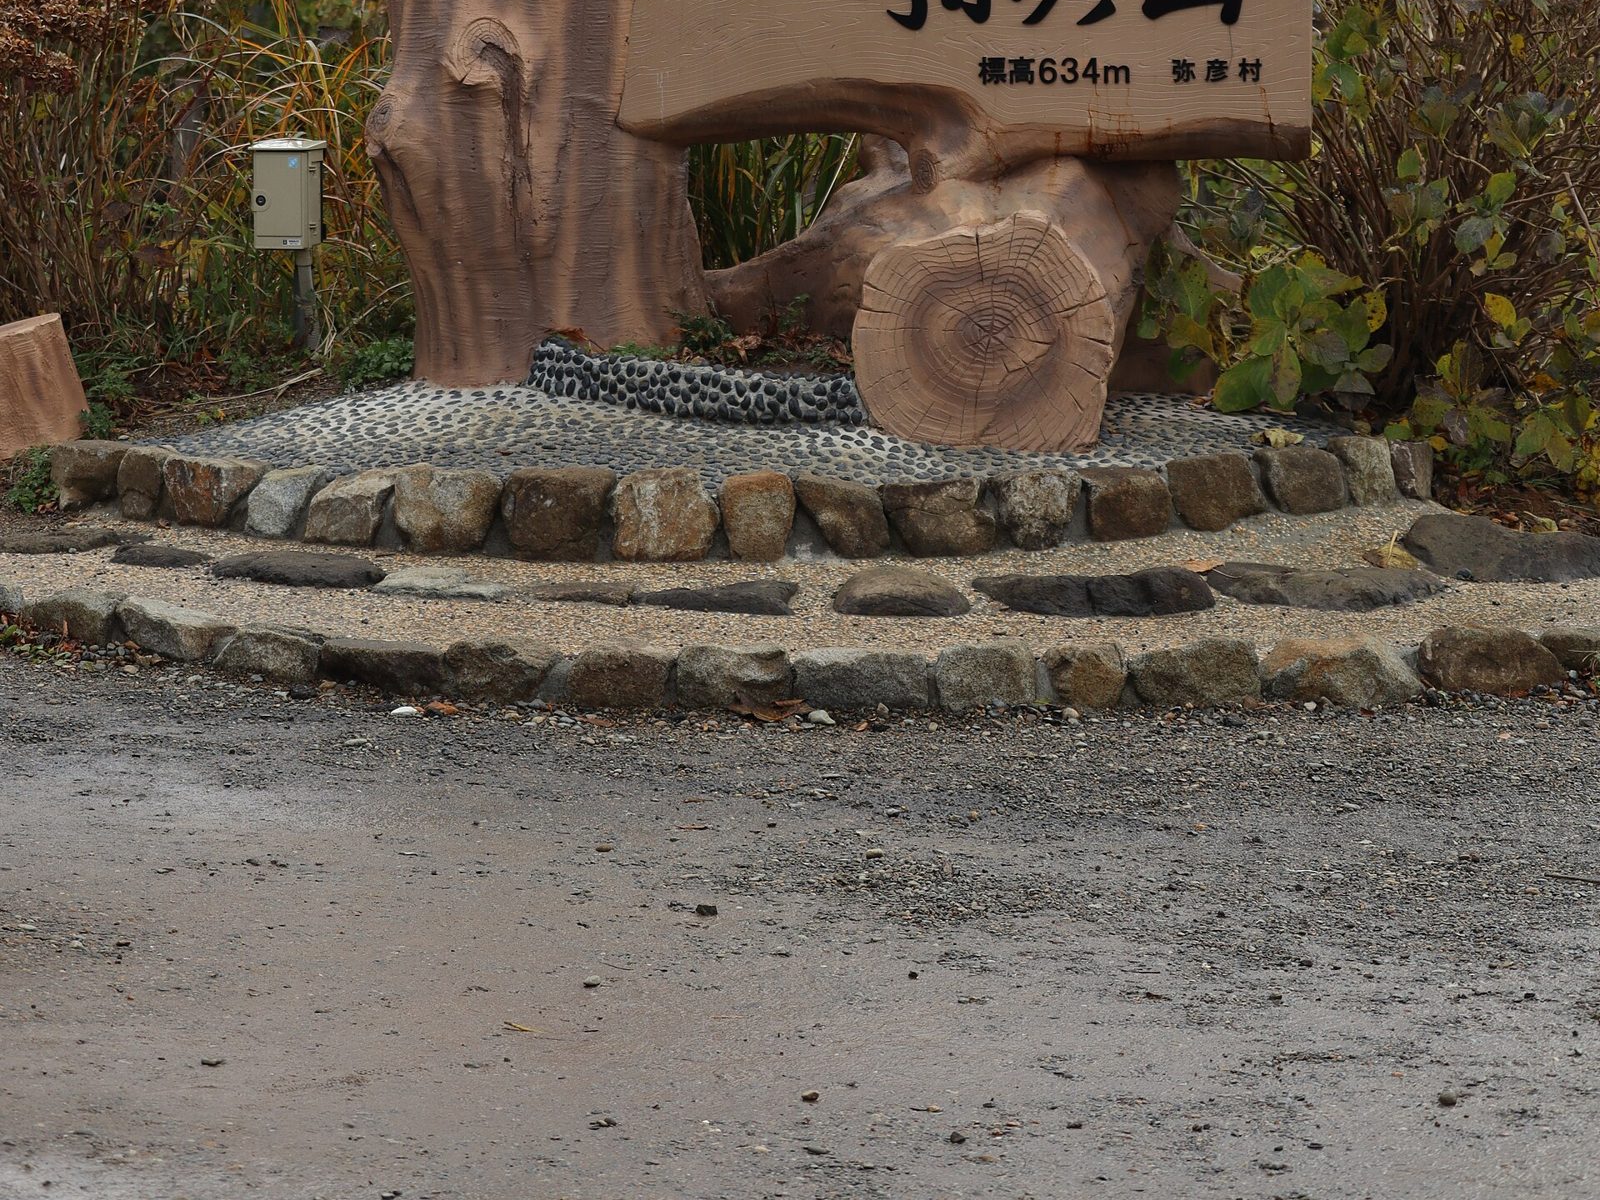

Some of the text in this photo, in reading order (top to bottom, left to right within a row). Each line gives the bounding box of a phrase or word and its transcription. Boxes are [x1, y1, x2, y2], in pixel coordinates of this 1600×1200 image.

[977, 56, 1263, 86] 標高634m 弥彦村
